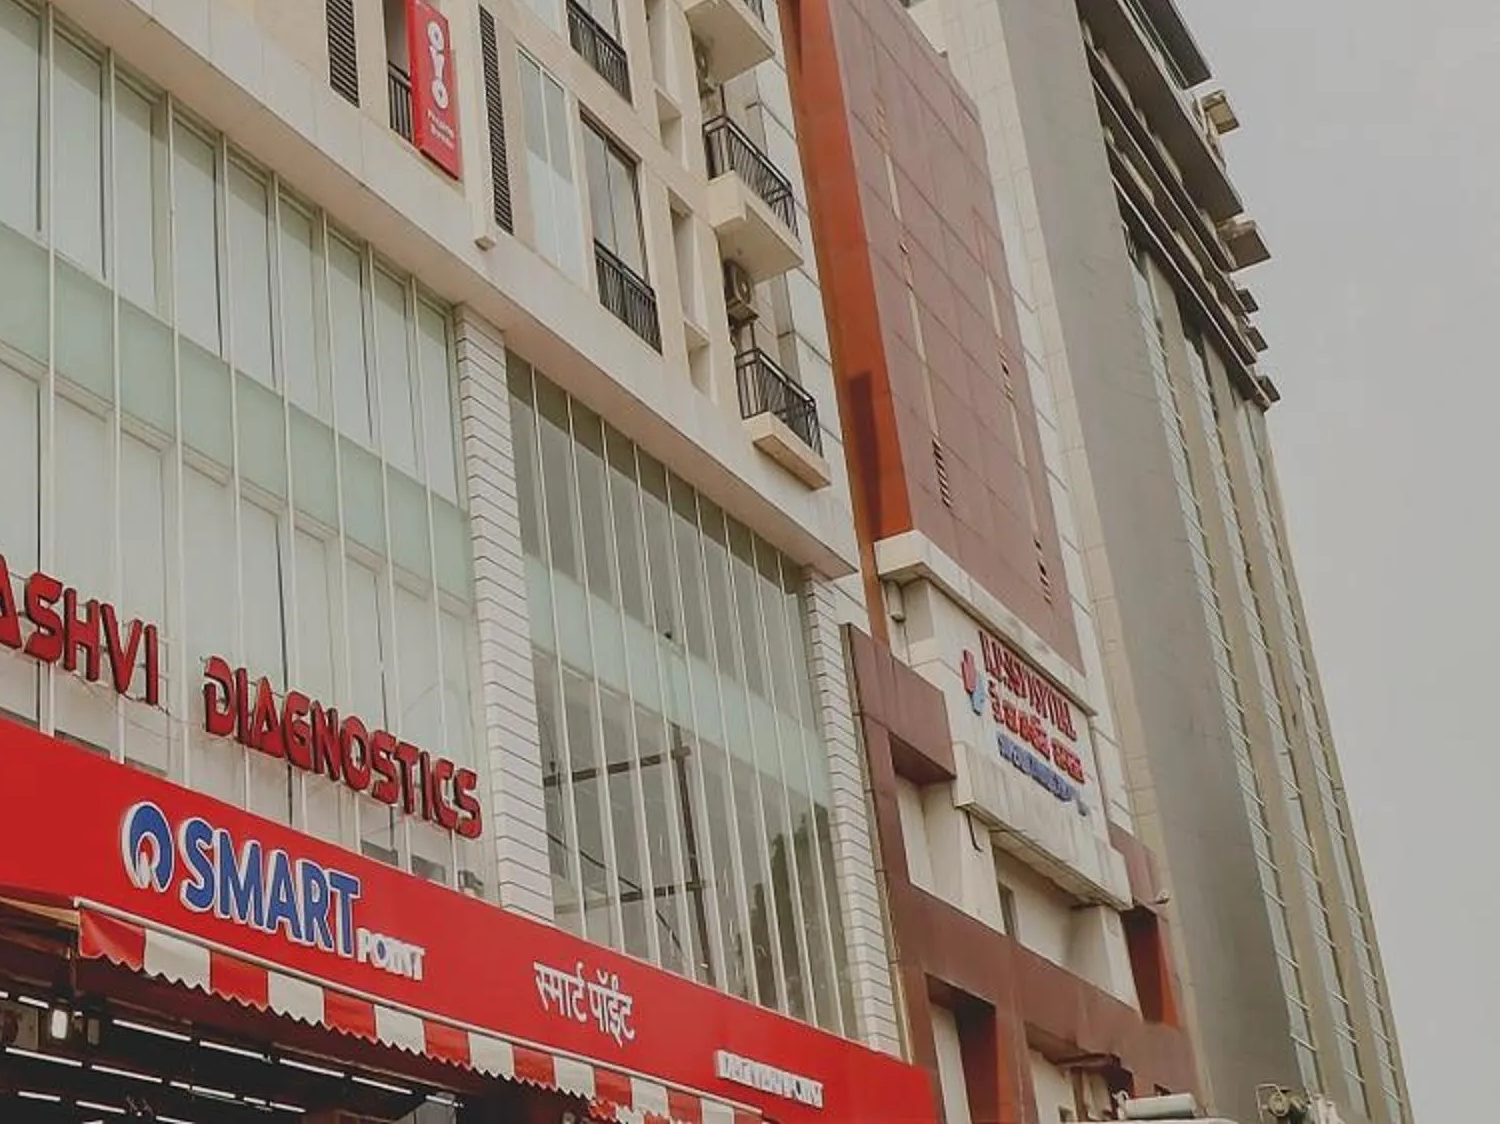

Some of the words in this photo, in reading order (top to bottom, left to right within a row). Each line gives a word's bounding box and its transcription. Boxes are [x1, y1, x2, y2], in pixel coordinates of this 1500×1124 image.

[204, 655, 482, 839] DIAGNOSTICS
[179, 818, 361, 959] SMART
[357, 929, 425, 980] POINT
[533, 961, 587, 1022] स्मार्ट
